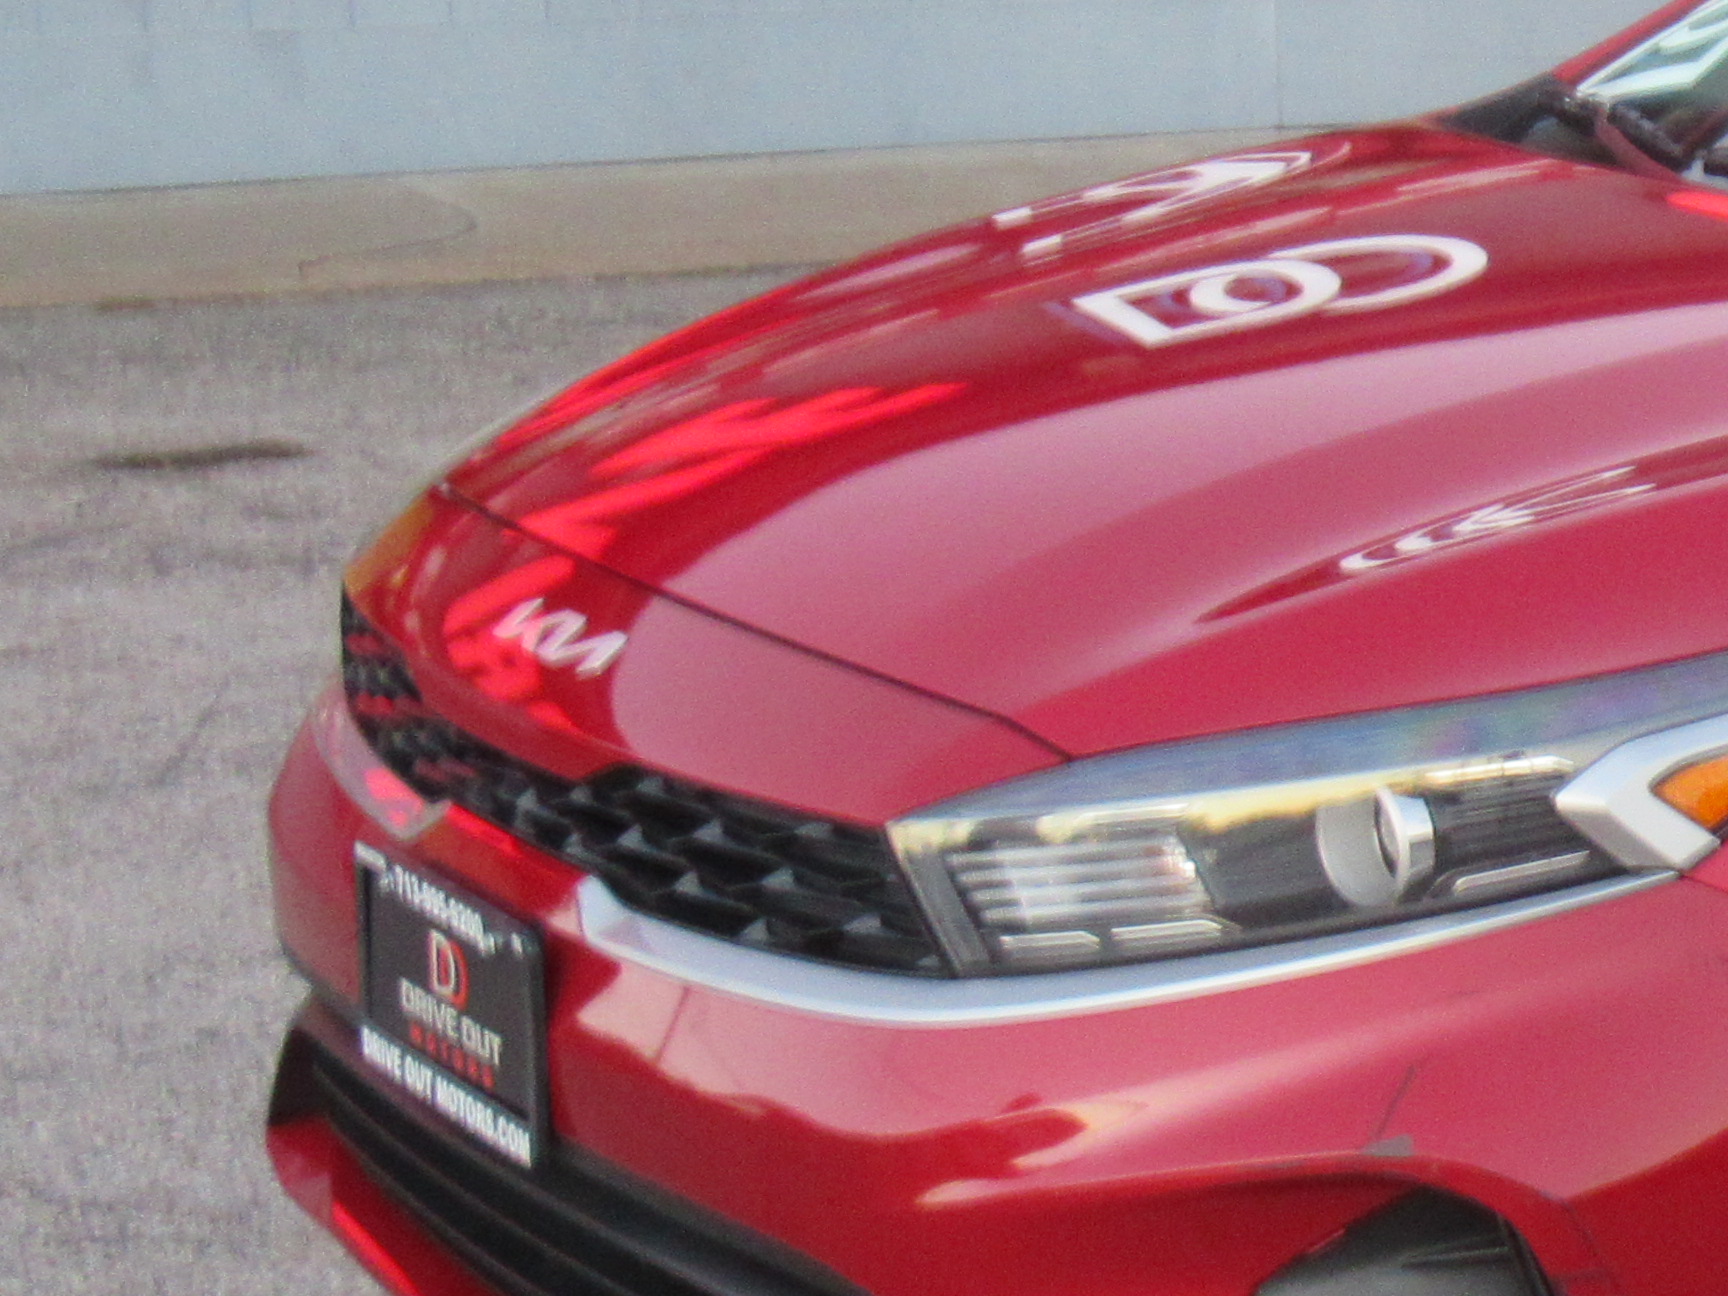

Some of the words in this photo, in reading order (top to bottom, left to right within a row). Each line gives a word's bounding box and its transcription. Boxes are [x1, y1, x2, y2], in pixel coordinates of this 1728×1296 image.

[400, 977, 458, 1044] DRIVE
[461, 1015, 502, 1065] OUT
[361, 1025, 402, 1082] DRIVE
[404, 1055, 433, 1102] OUT
